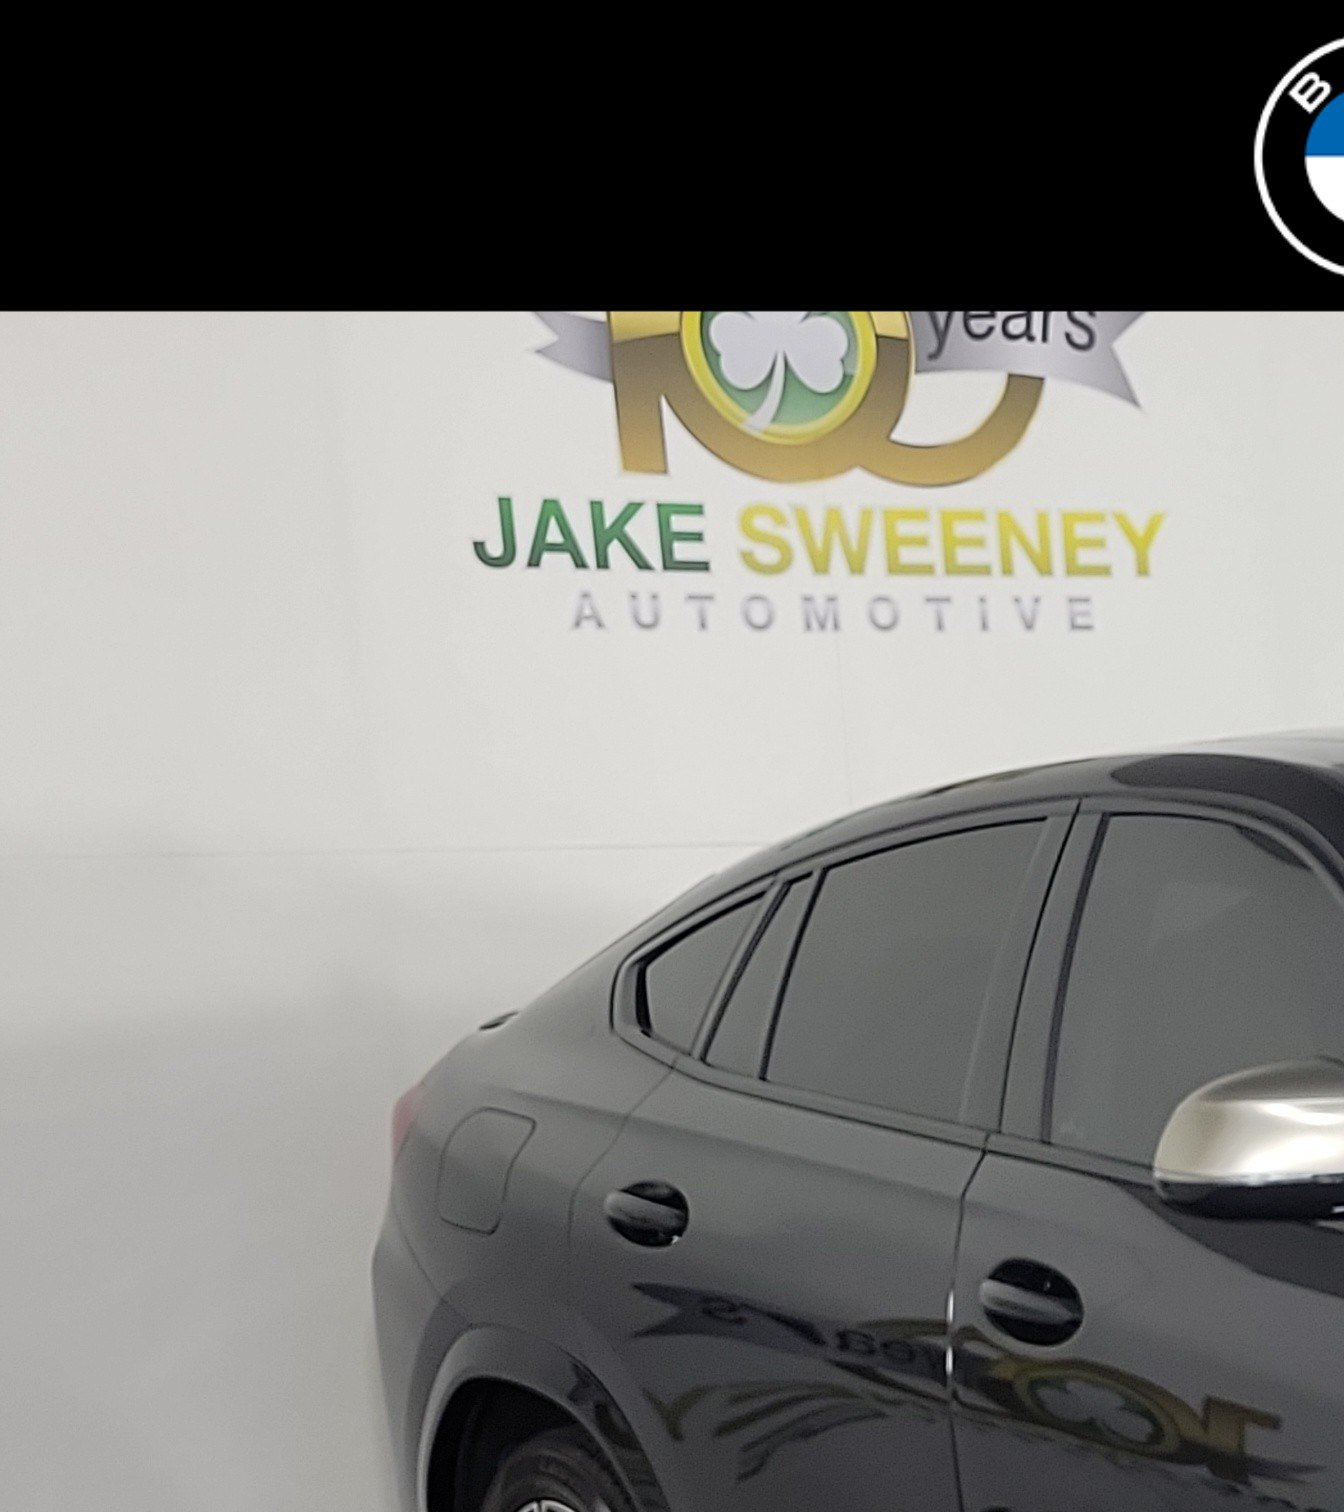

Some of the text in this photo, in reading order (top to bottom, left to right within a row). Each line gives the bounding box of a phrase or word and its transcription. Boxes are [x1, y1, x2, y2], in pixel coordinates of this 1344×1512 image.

[472, 496, 1167, 578] JAKE SWEENEY
[570, 591, 1096, 633] AUTOMOTIVE
